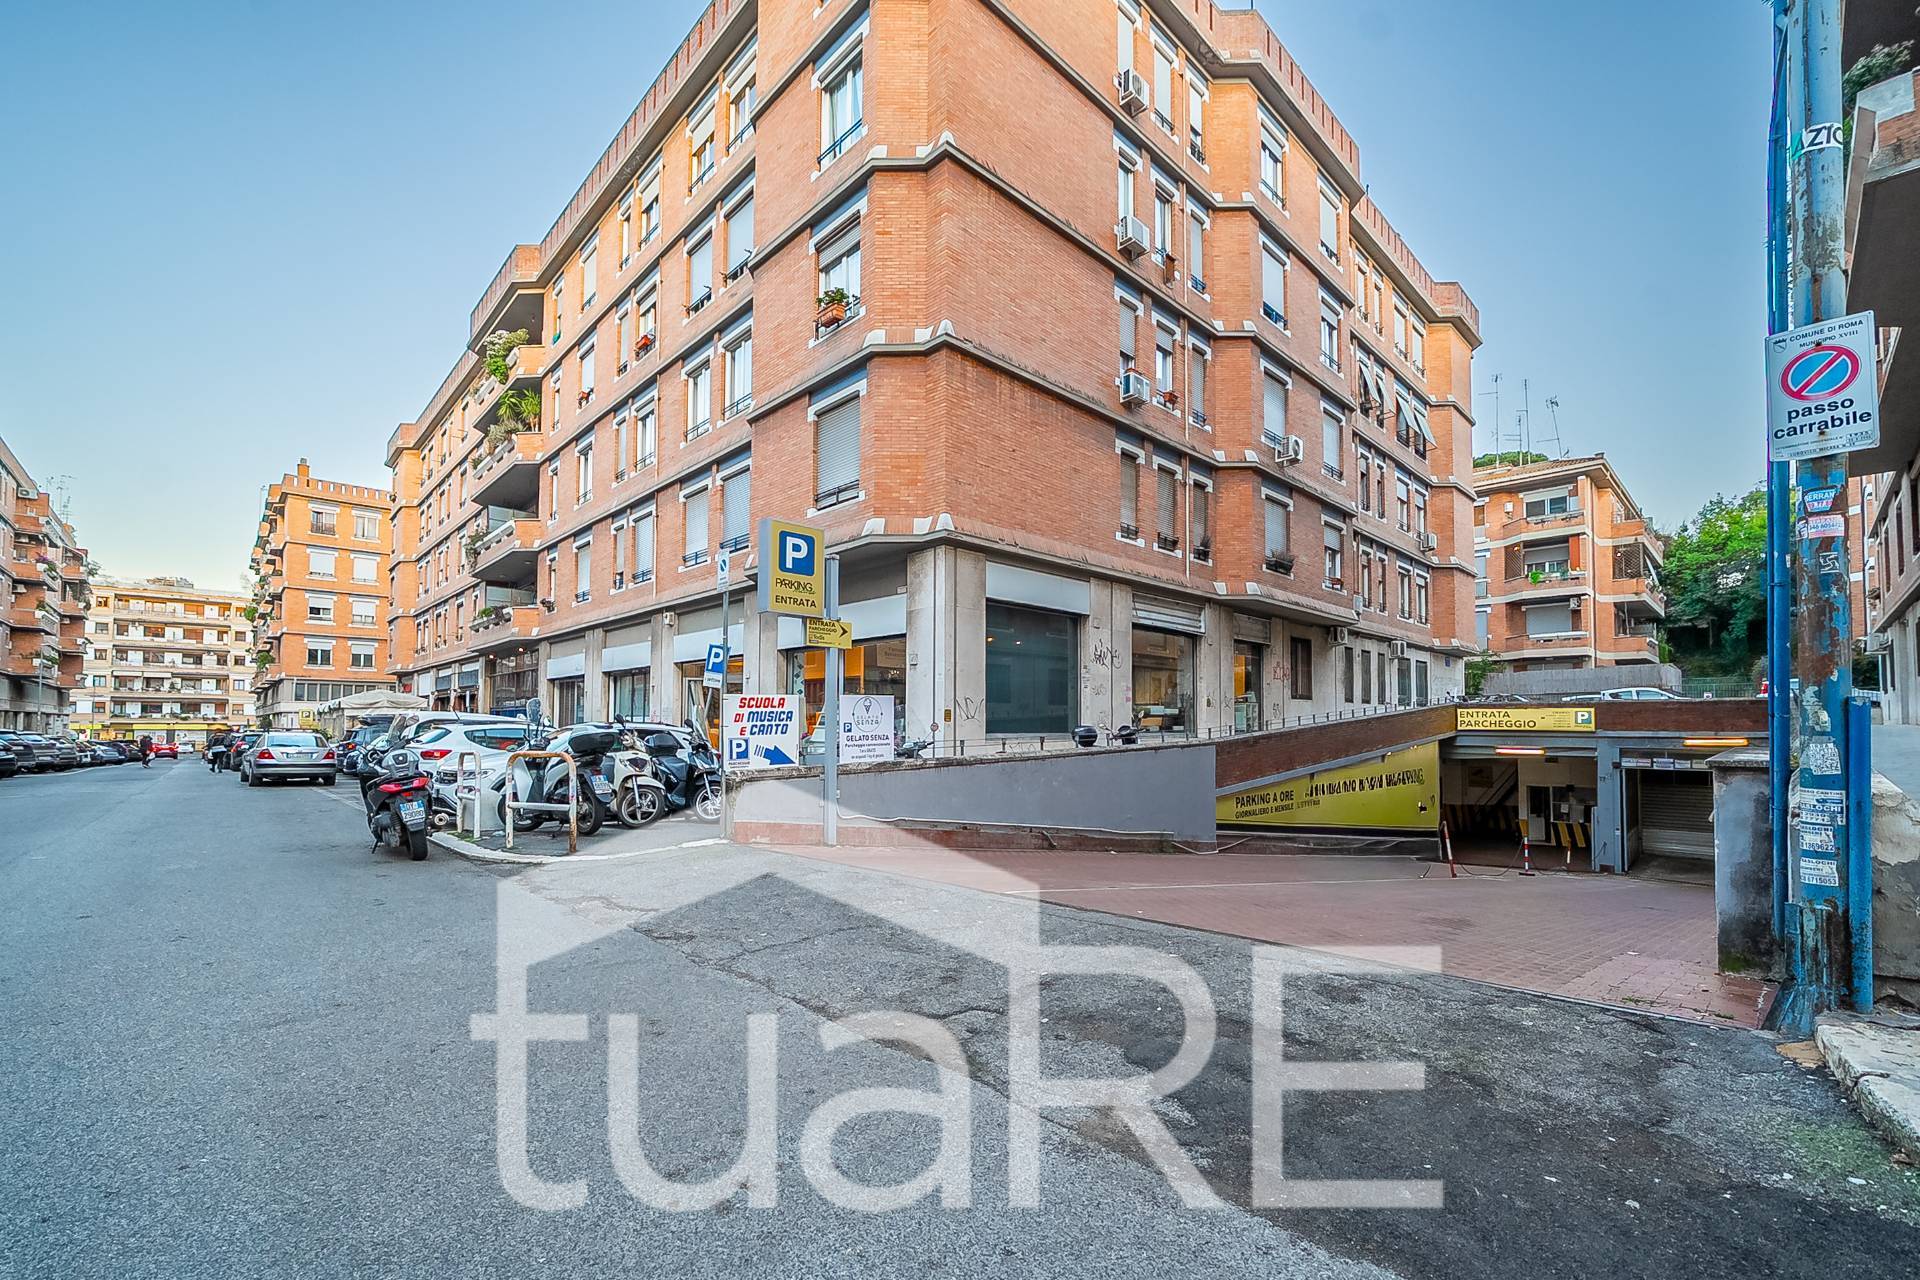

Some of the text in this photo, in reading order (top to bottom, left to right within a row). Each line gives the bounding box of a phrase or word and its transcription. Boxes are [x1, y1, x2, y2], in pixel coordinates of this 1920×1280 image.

[1789, 329, 1825, 342] COMUNE
[1838, 319, 1864, 330] ROMA
[1799, 335, 1837, 348] MUNICIPIO
[1787, 398, 1855, 423] passo
[1773, 411, 1873, 440] carrabile
[785, 535, 808, 569] P
[775, 578, 813, 592] PARKING
[775, 595, 817, 608] ENTRATA
[809, 619, 836, 628] ENTRATA
[708, 647, 724, 670] P
[739, 696, 786, 709] SCUOLA
[734, 710, 794, 723] DI MUSICA
[1459, 711, 1511, 719] ENTRATA
[1577, 711, 1589, 724] P
[740, 723, 789, 736] E CANTO
[844, 723, 851, 732] P
[1459, 720, 1537, 729] PARCHEGGIO
[732, 739, 747, 760] P
[1235, 790, 1295, 808] PARKING A ORE
[1235, 807, 1269, 819] GIORNALIERO
[1275, 803, 1294, 815] MENSILE
